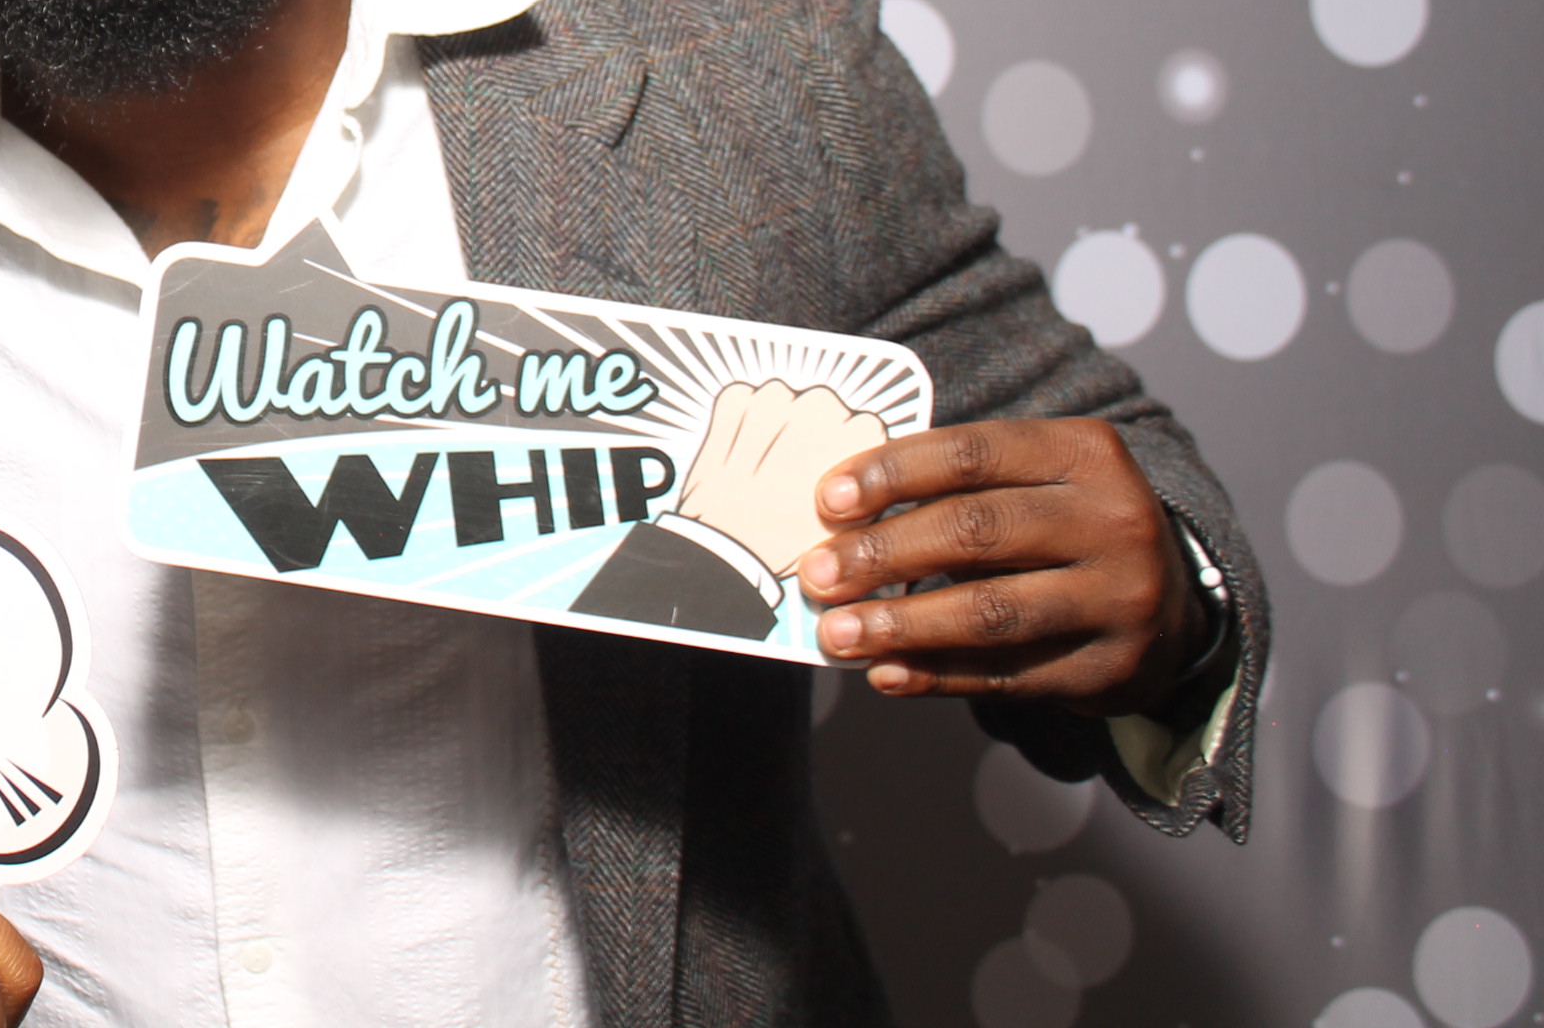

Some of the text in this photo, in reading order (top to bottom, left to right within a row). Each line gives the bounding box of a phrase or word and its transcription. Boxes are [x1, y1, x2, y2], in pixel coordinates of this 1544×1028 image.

[165, 297, 658, 426] Watch me
[196, 446, 677, 573] WHIP
